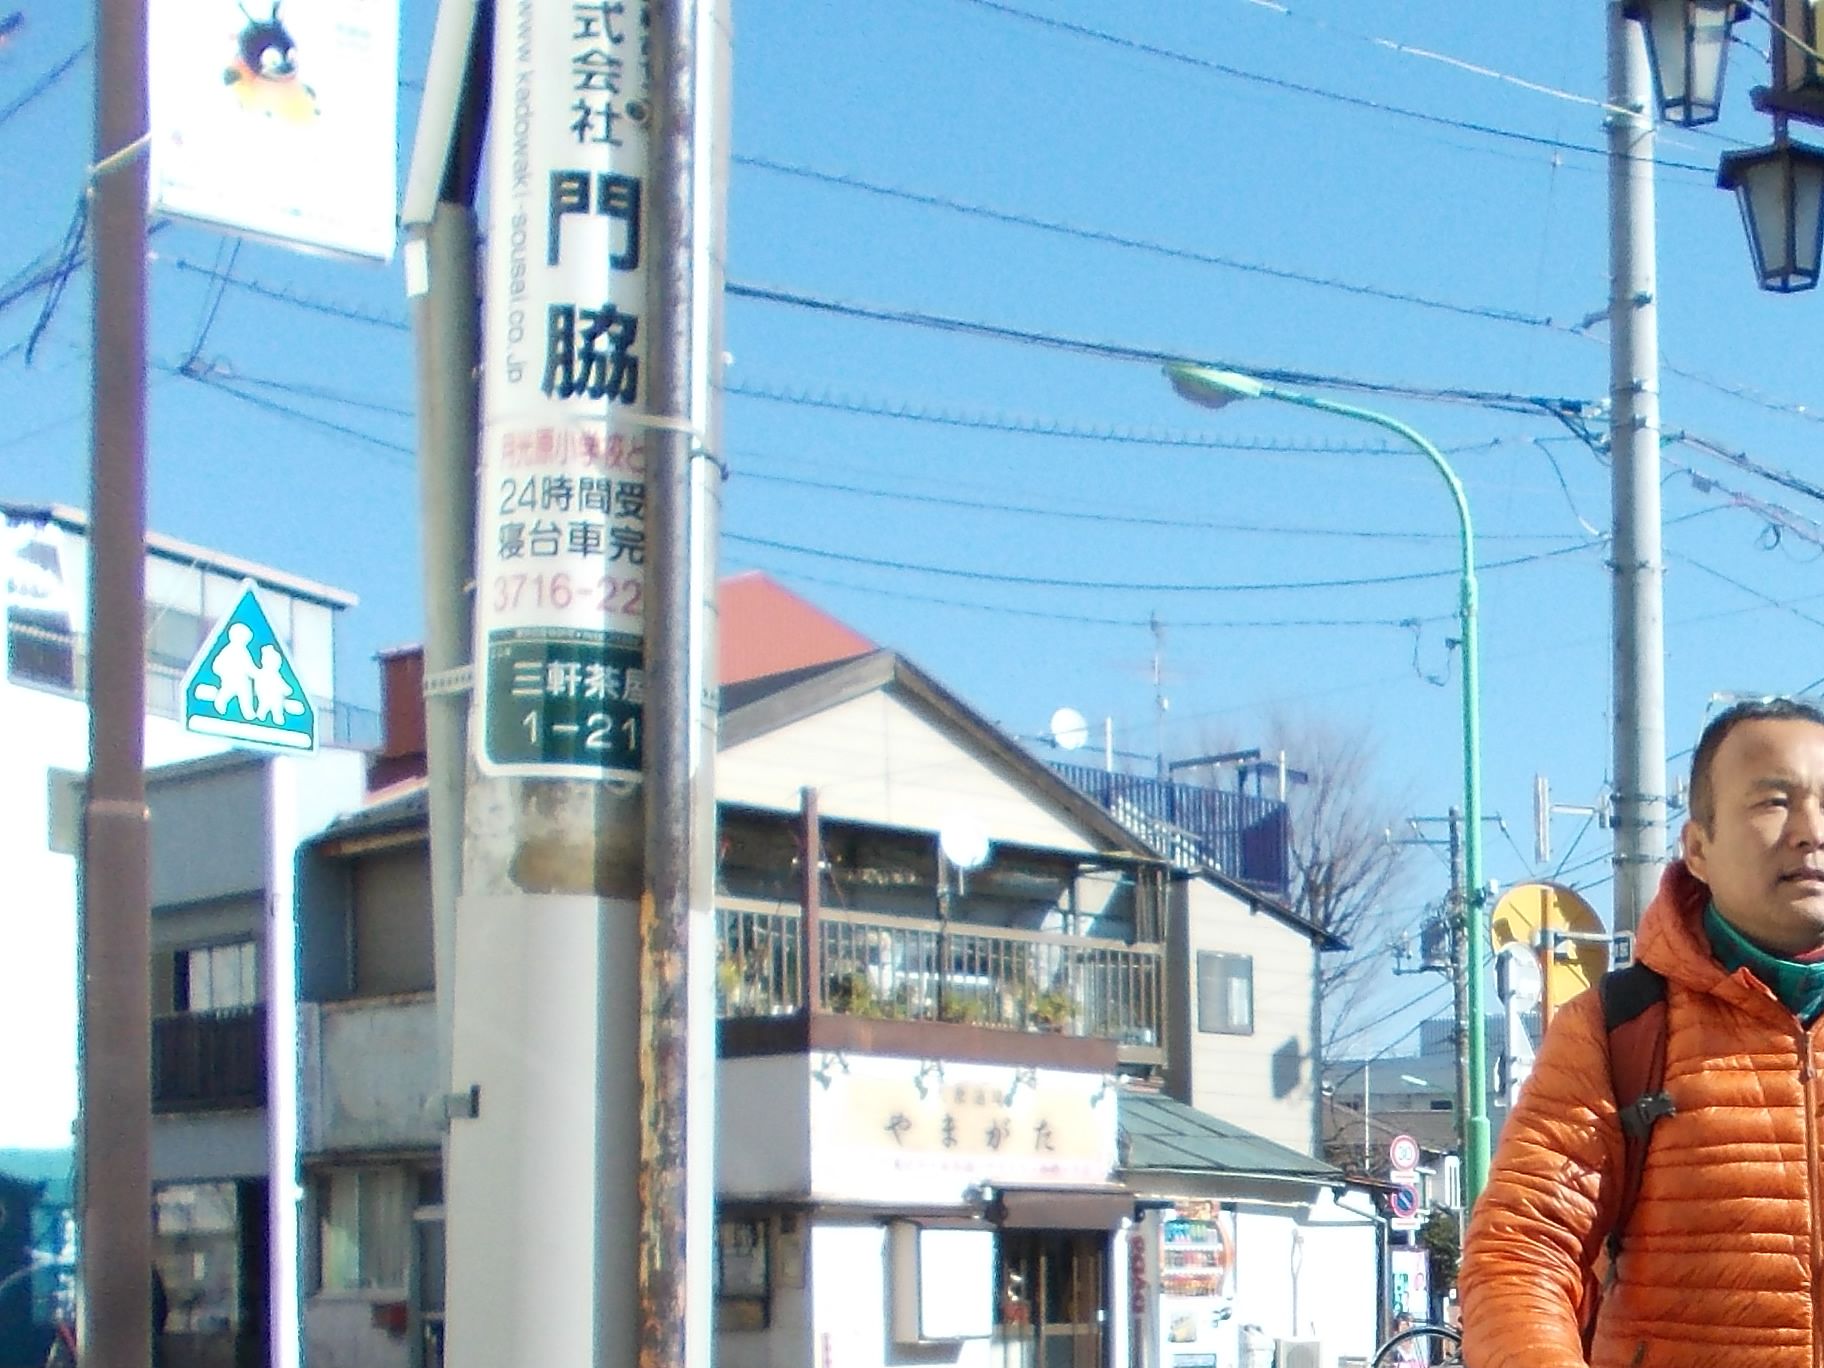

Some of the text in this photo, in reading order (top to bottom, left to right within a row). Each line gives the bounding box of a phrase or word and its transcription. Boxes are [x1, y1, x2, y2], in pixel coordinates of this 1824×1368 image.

[541, 167, 642, 405] 門脇
[493, 572, 643, 616] 3716-22
[522, 709, 638, 751] 1-21
[884, 1110, 1055, 1151] やまがた
[1397, 1144, 1413, 1161] 30
